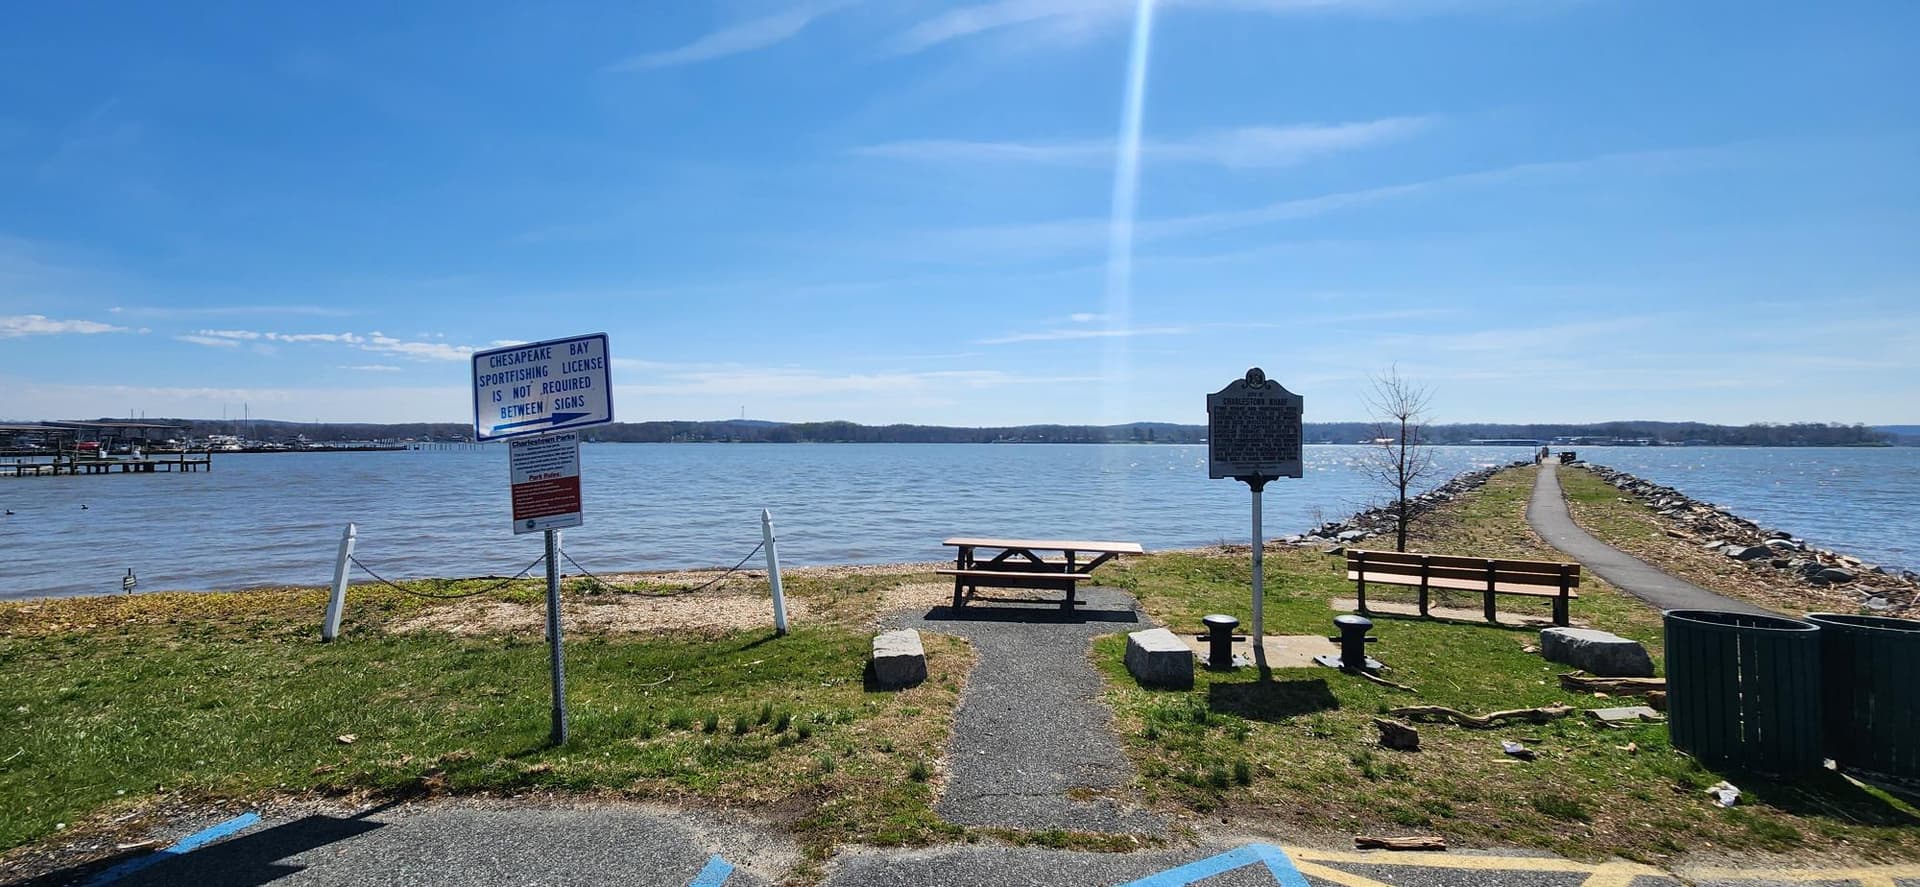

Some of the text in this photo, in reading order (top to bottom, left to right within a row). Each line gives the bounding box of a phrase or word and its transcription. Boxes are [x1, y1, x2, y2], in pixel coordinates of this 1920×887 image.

[490, 341, 589, 368] CHESAPEAKE BAY
[479, 356, 603, 388] SPORTFISHING LICENSE
[492, 376, 591, 402] IS NOT REQUIRED
[500, 395, 585, 419] BETWEEN SIGNS
